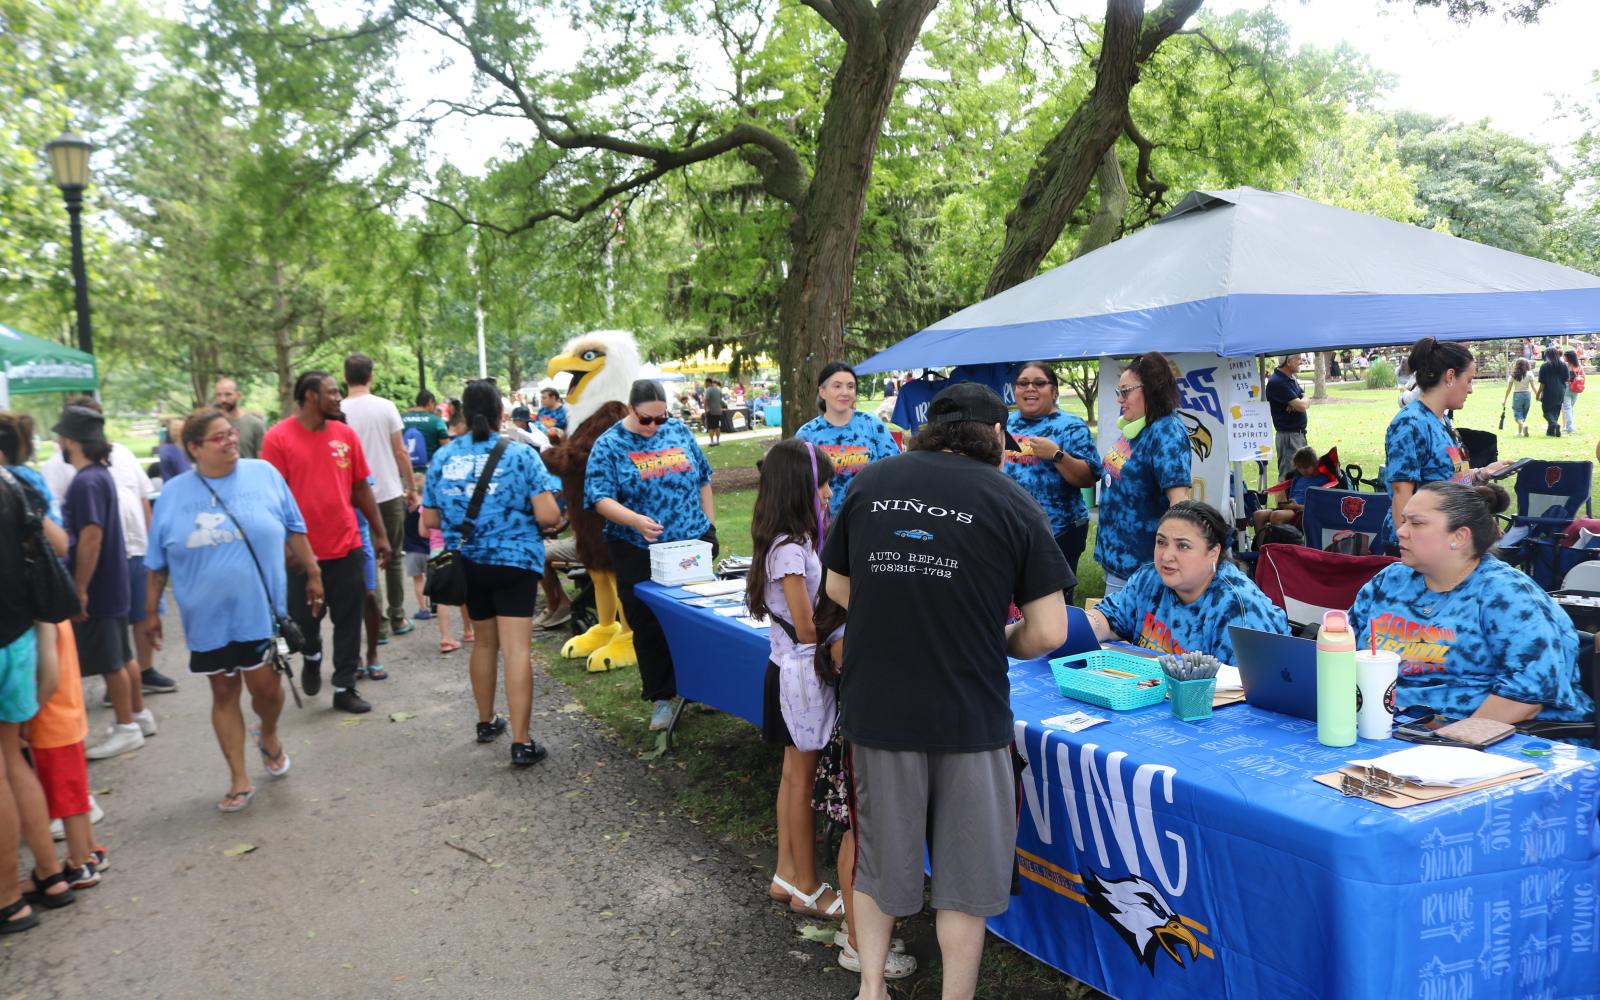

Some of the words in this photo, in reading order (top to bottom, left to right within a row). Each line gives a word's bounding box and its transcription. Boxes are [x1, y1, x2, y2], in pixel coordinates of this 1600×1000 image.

[1229, 360, 1252, 370] SPIRIT
[1232, 372, 1252, 381] WEAR
[1233, 431, 1268, 439] ESPÍRITU
[871, 498, 973, 524] NIÑO'S
[868, 551, 901, 562] AUTO
[908, 552, 959, 569] REPAIR
[870, 563, 952, 578] (708)315-1762
[1421, 886, 1474, 927] IRVING
[1571, 883, 1594, 952] IRVING
[1491, 900, 1513, 976] IRVING
